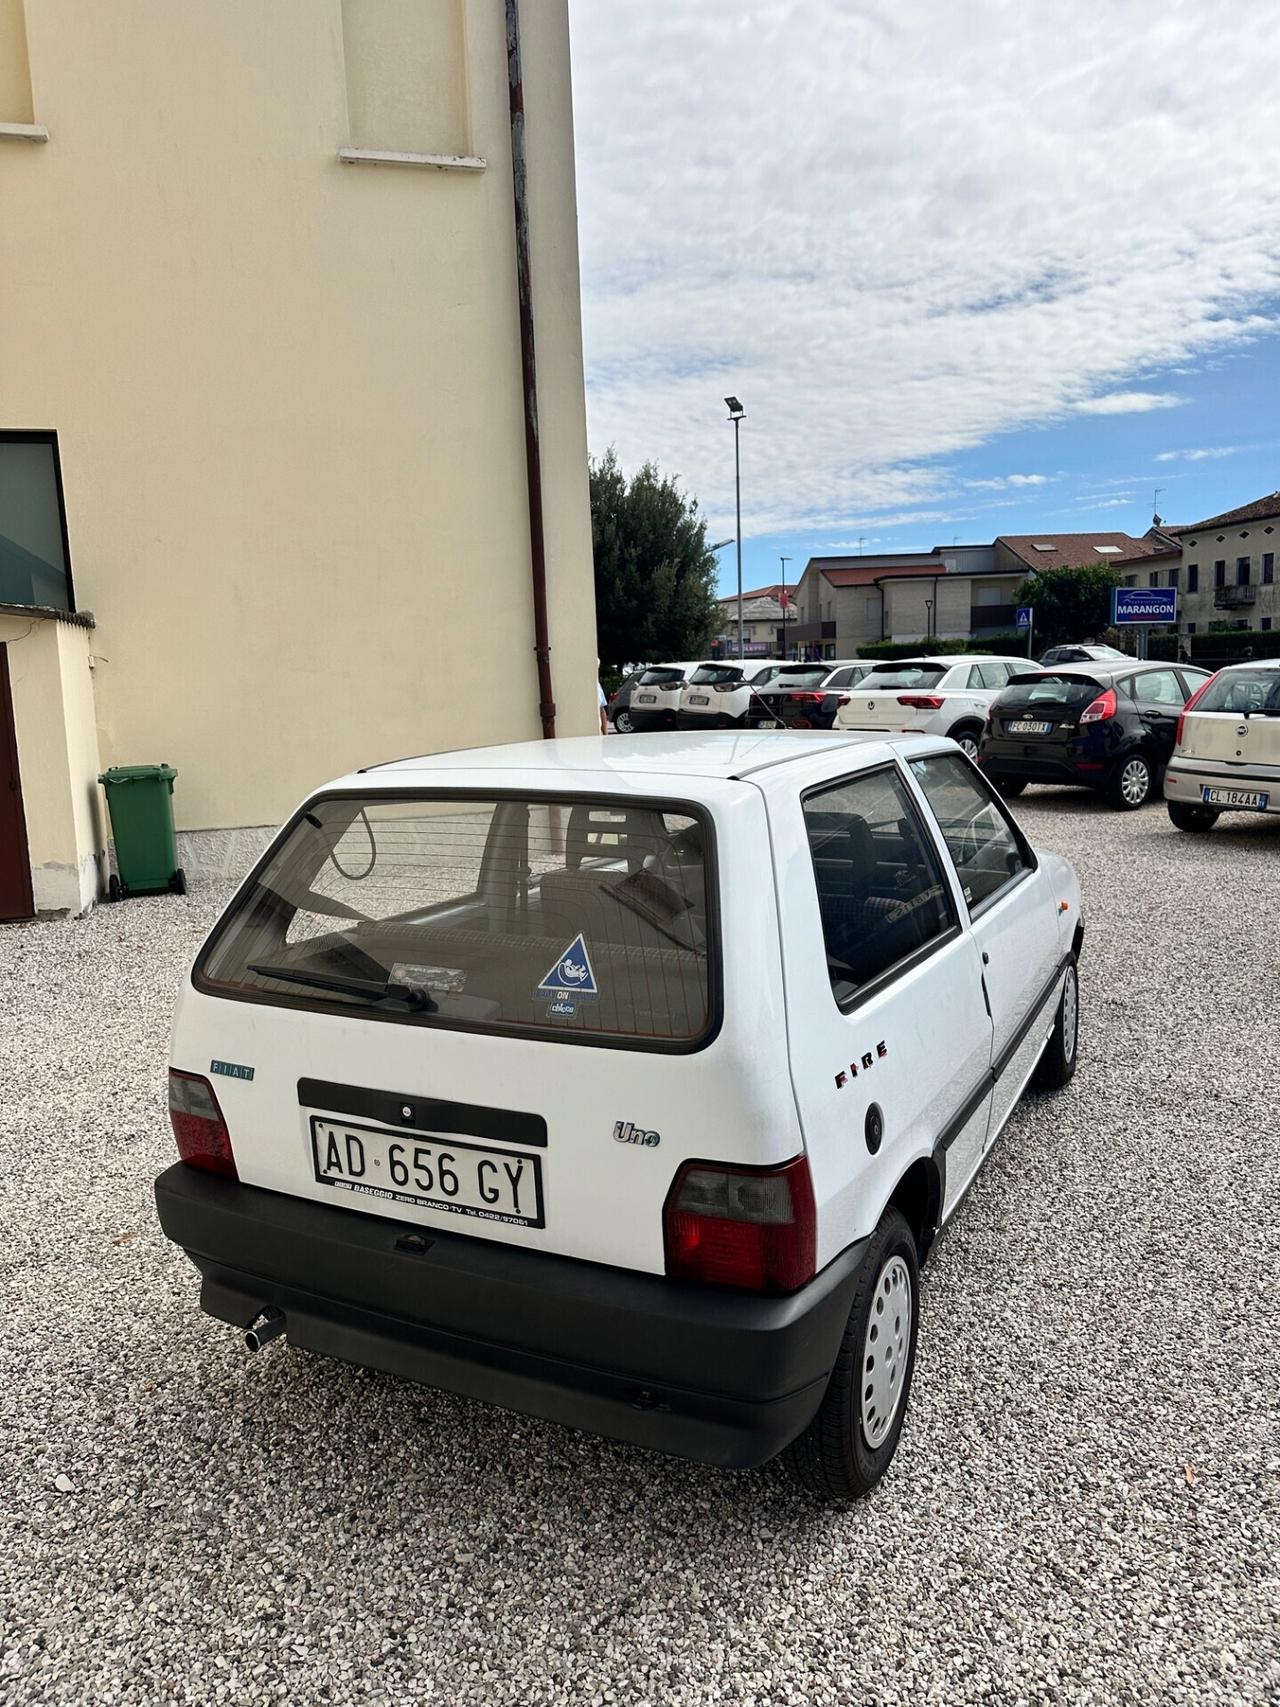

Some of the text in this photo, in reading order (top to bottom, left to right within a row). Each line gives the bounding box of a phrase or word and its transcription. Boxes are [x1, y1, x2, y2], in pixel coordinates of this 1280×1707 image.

[1117, 604, 1174, 615] MARANGON
[1012, 721, 1021, 732] FC
[1210, 790, 1257, 806] CL 184AA
[556, 991, 570, 1000] ON
[212, 1062, 251, 1079] FIAT
[834, 1040, 888, 1090] FIRE
[613, 1120, 661, 1148] Uno
[326, 1131, 524, 1209] AD 656 GY
[354, 1184, 393, 1199] BASEGGIO
[395, 1194, 416, 1203] ZERO
